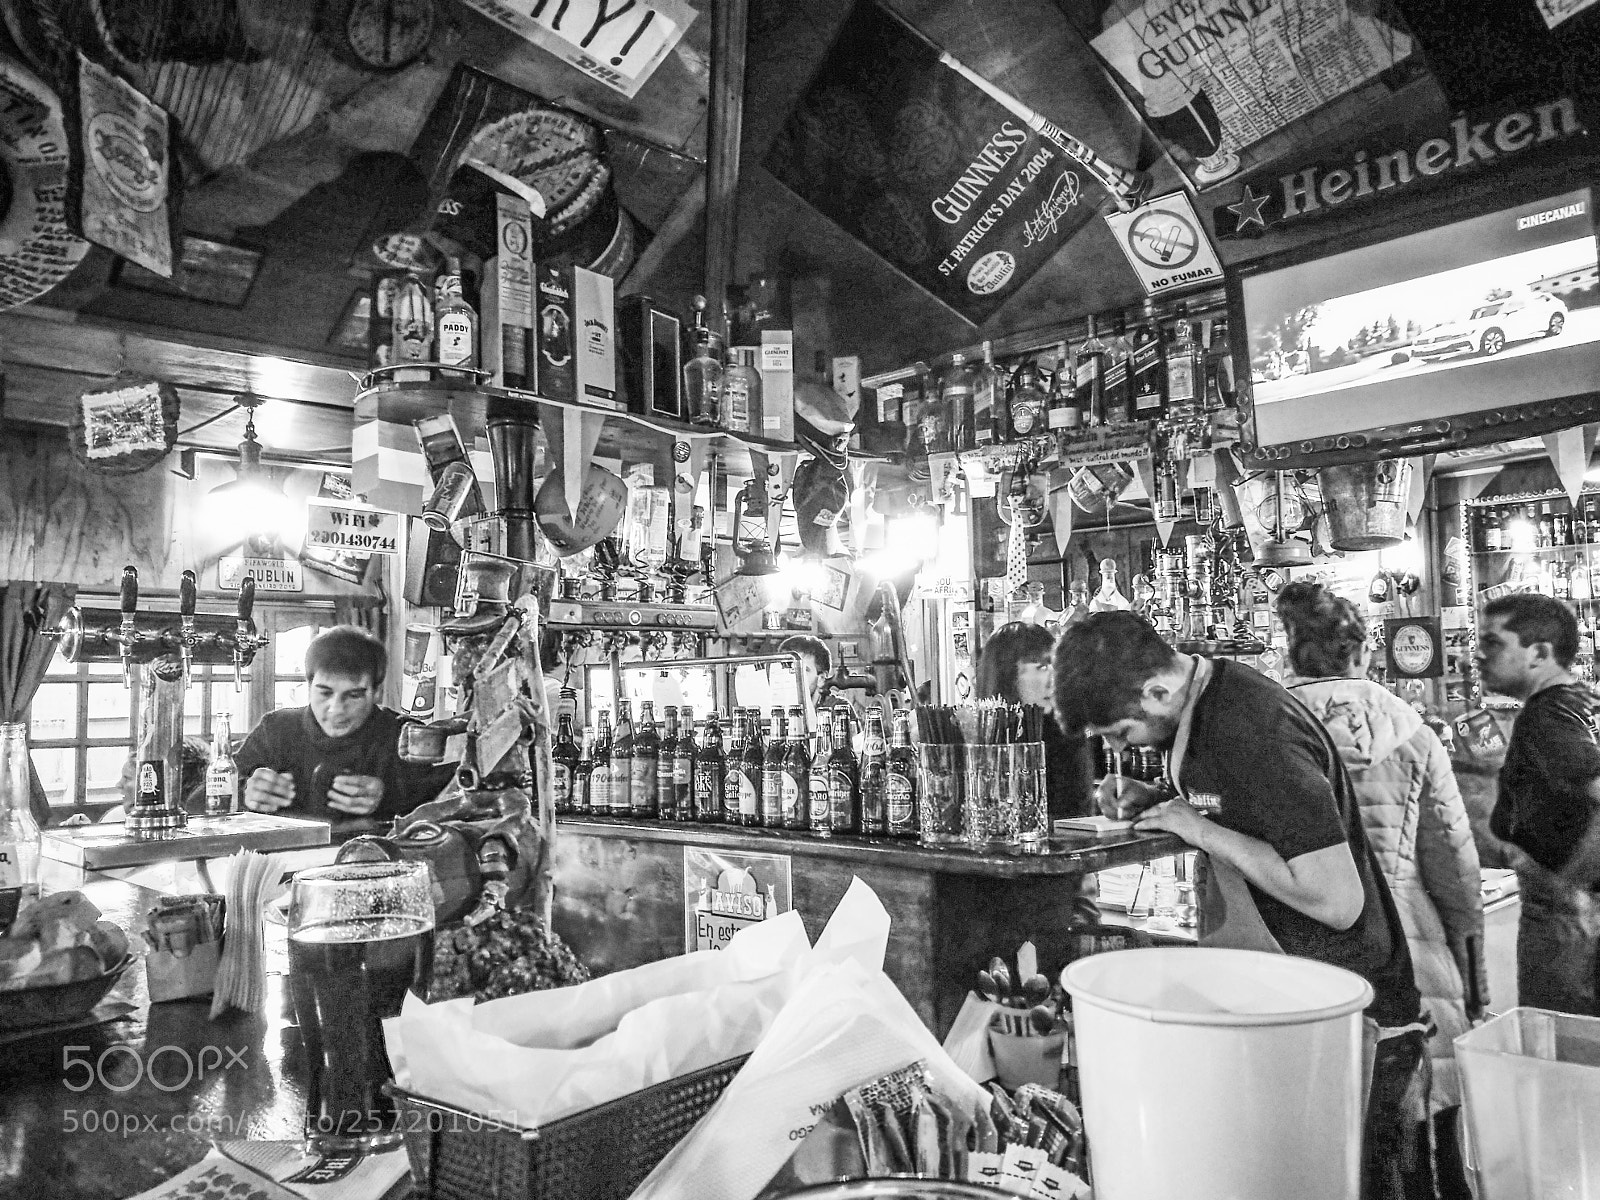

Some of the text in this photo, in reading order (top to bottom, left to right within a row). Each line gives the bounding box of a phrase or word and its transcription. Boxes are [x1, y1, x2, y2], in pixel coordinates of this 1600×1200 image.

[1137, 0, 1272, 80] GUINNE
[575, 55, 622, 86] DHL
[1279, 97, 1582, 219] Heineken
[931, 120, 1028, 225] GUINNESS
[937, 258, 958, 277] ST.
[949, 203, 1004, 263] PATRICK'S
[997, 176, 1026, 209] DAY
[1020, 146, 1055, 183] 2004
[1517, 201, 1586, 230] CINECANAL
[1151, 267, 1214, 289] NO FUMAR
[443, 324, 470, 333] PADDY
[311, 529, 397, 550] 2901430744
[248, 569, 294, 584] DUBLIN
[1395, 645, 1431, 653] GUINNESS
[713, 891, 762, 918] AVISO
[698, 914, 714, 939] En
